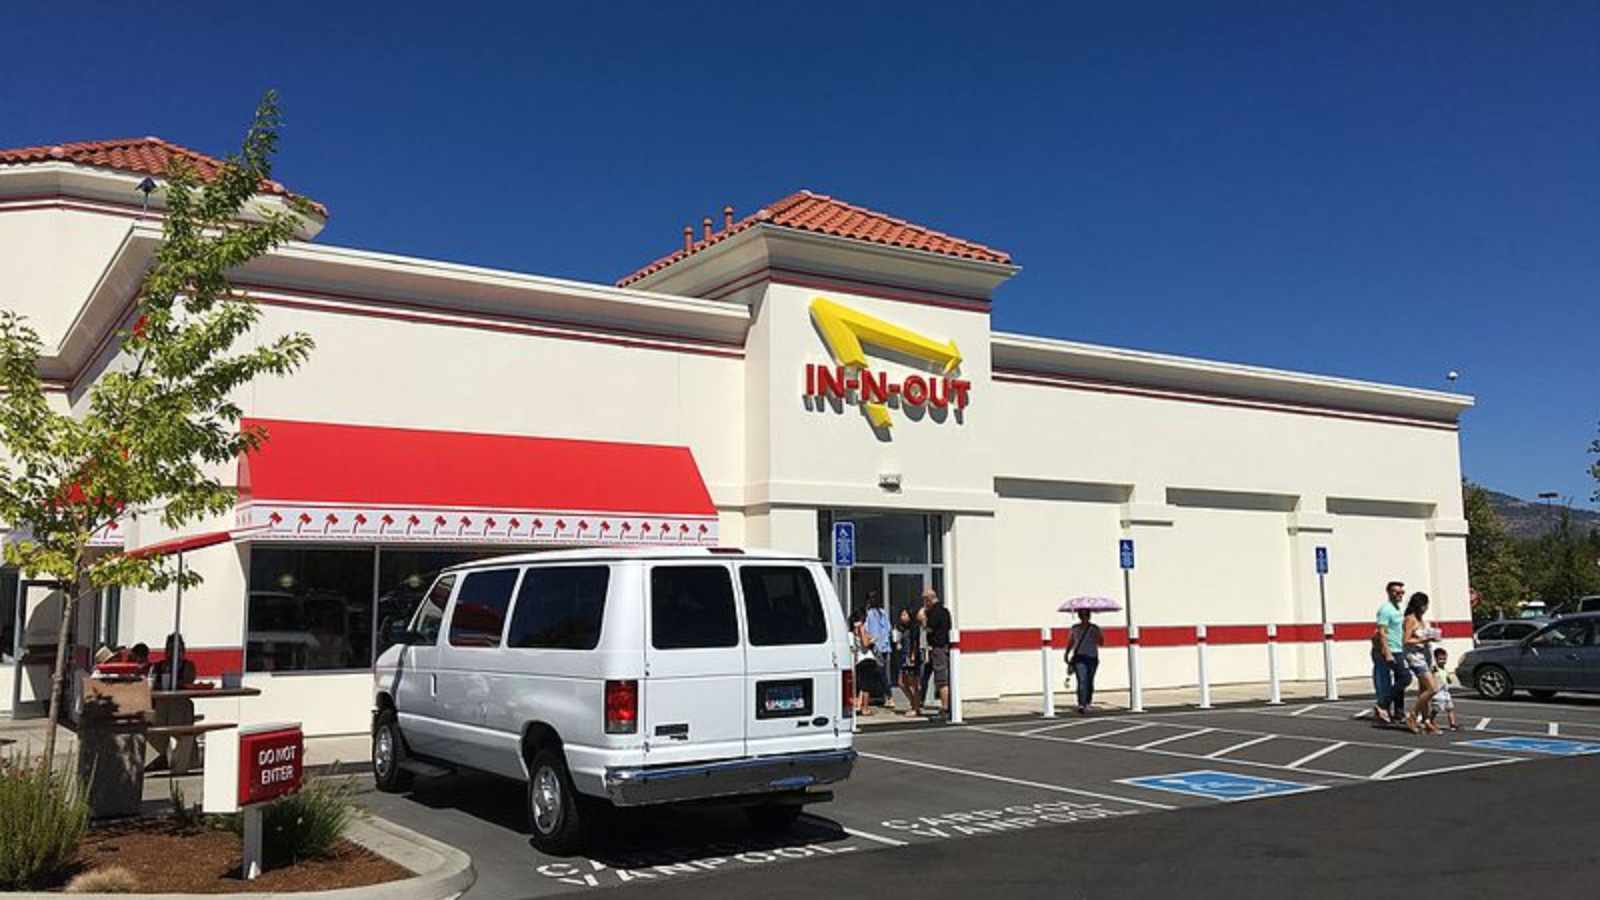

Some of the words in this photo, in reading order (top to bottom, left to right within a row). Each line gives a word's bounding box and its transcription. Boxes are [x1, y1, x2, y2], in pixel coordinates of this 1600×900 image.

[806, 364, 971, 409] IN-N-OUT
[258, 749, 275, 765] DO
[275, 745, 297, 761] NOT
[261, 766, 294, 784] ENTER
[557, 844, 856, 887] VANPOOL
